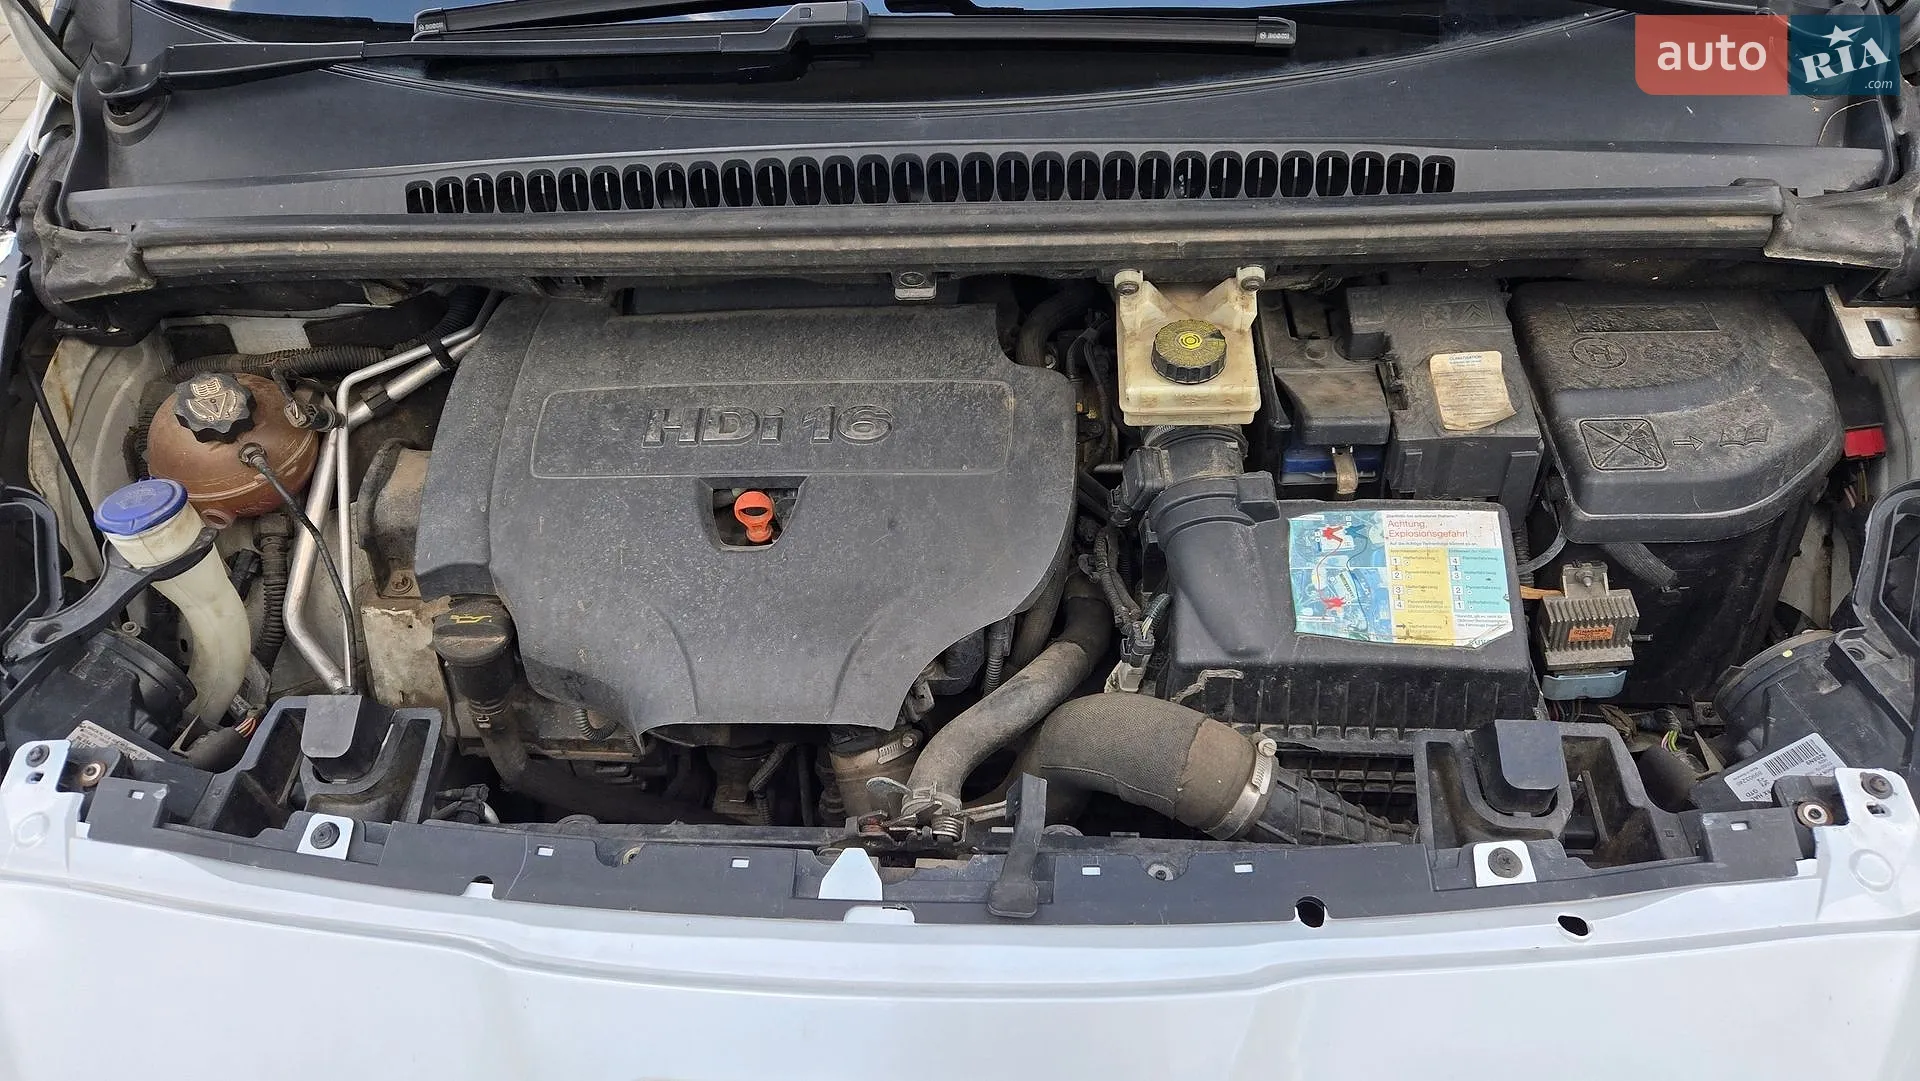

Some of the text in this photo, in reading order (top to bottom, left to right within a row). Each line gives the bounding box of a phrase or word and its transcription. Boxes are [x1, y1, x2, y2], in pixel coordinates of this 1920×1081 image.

[642, 403, 893, 447] HDi 16
[1388, 519, 1428, 530] Achtung,
[1388, 529, 1469, 539] Explosionsgefahr!
